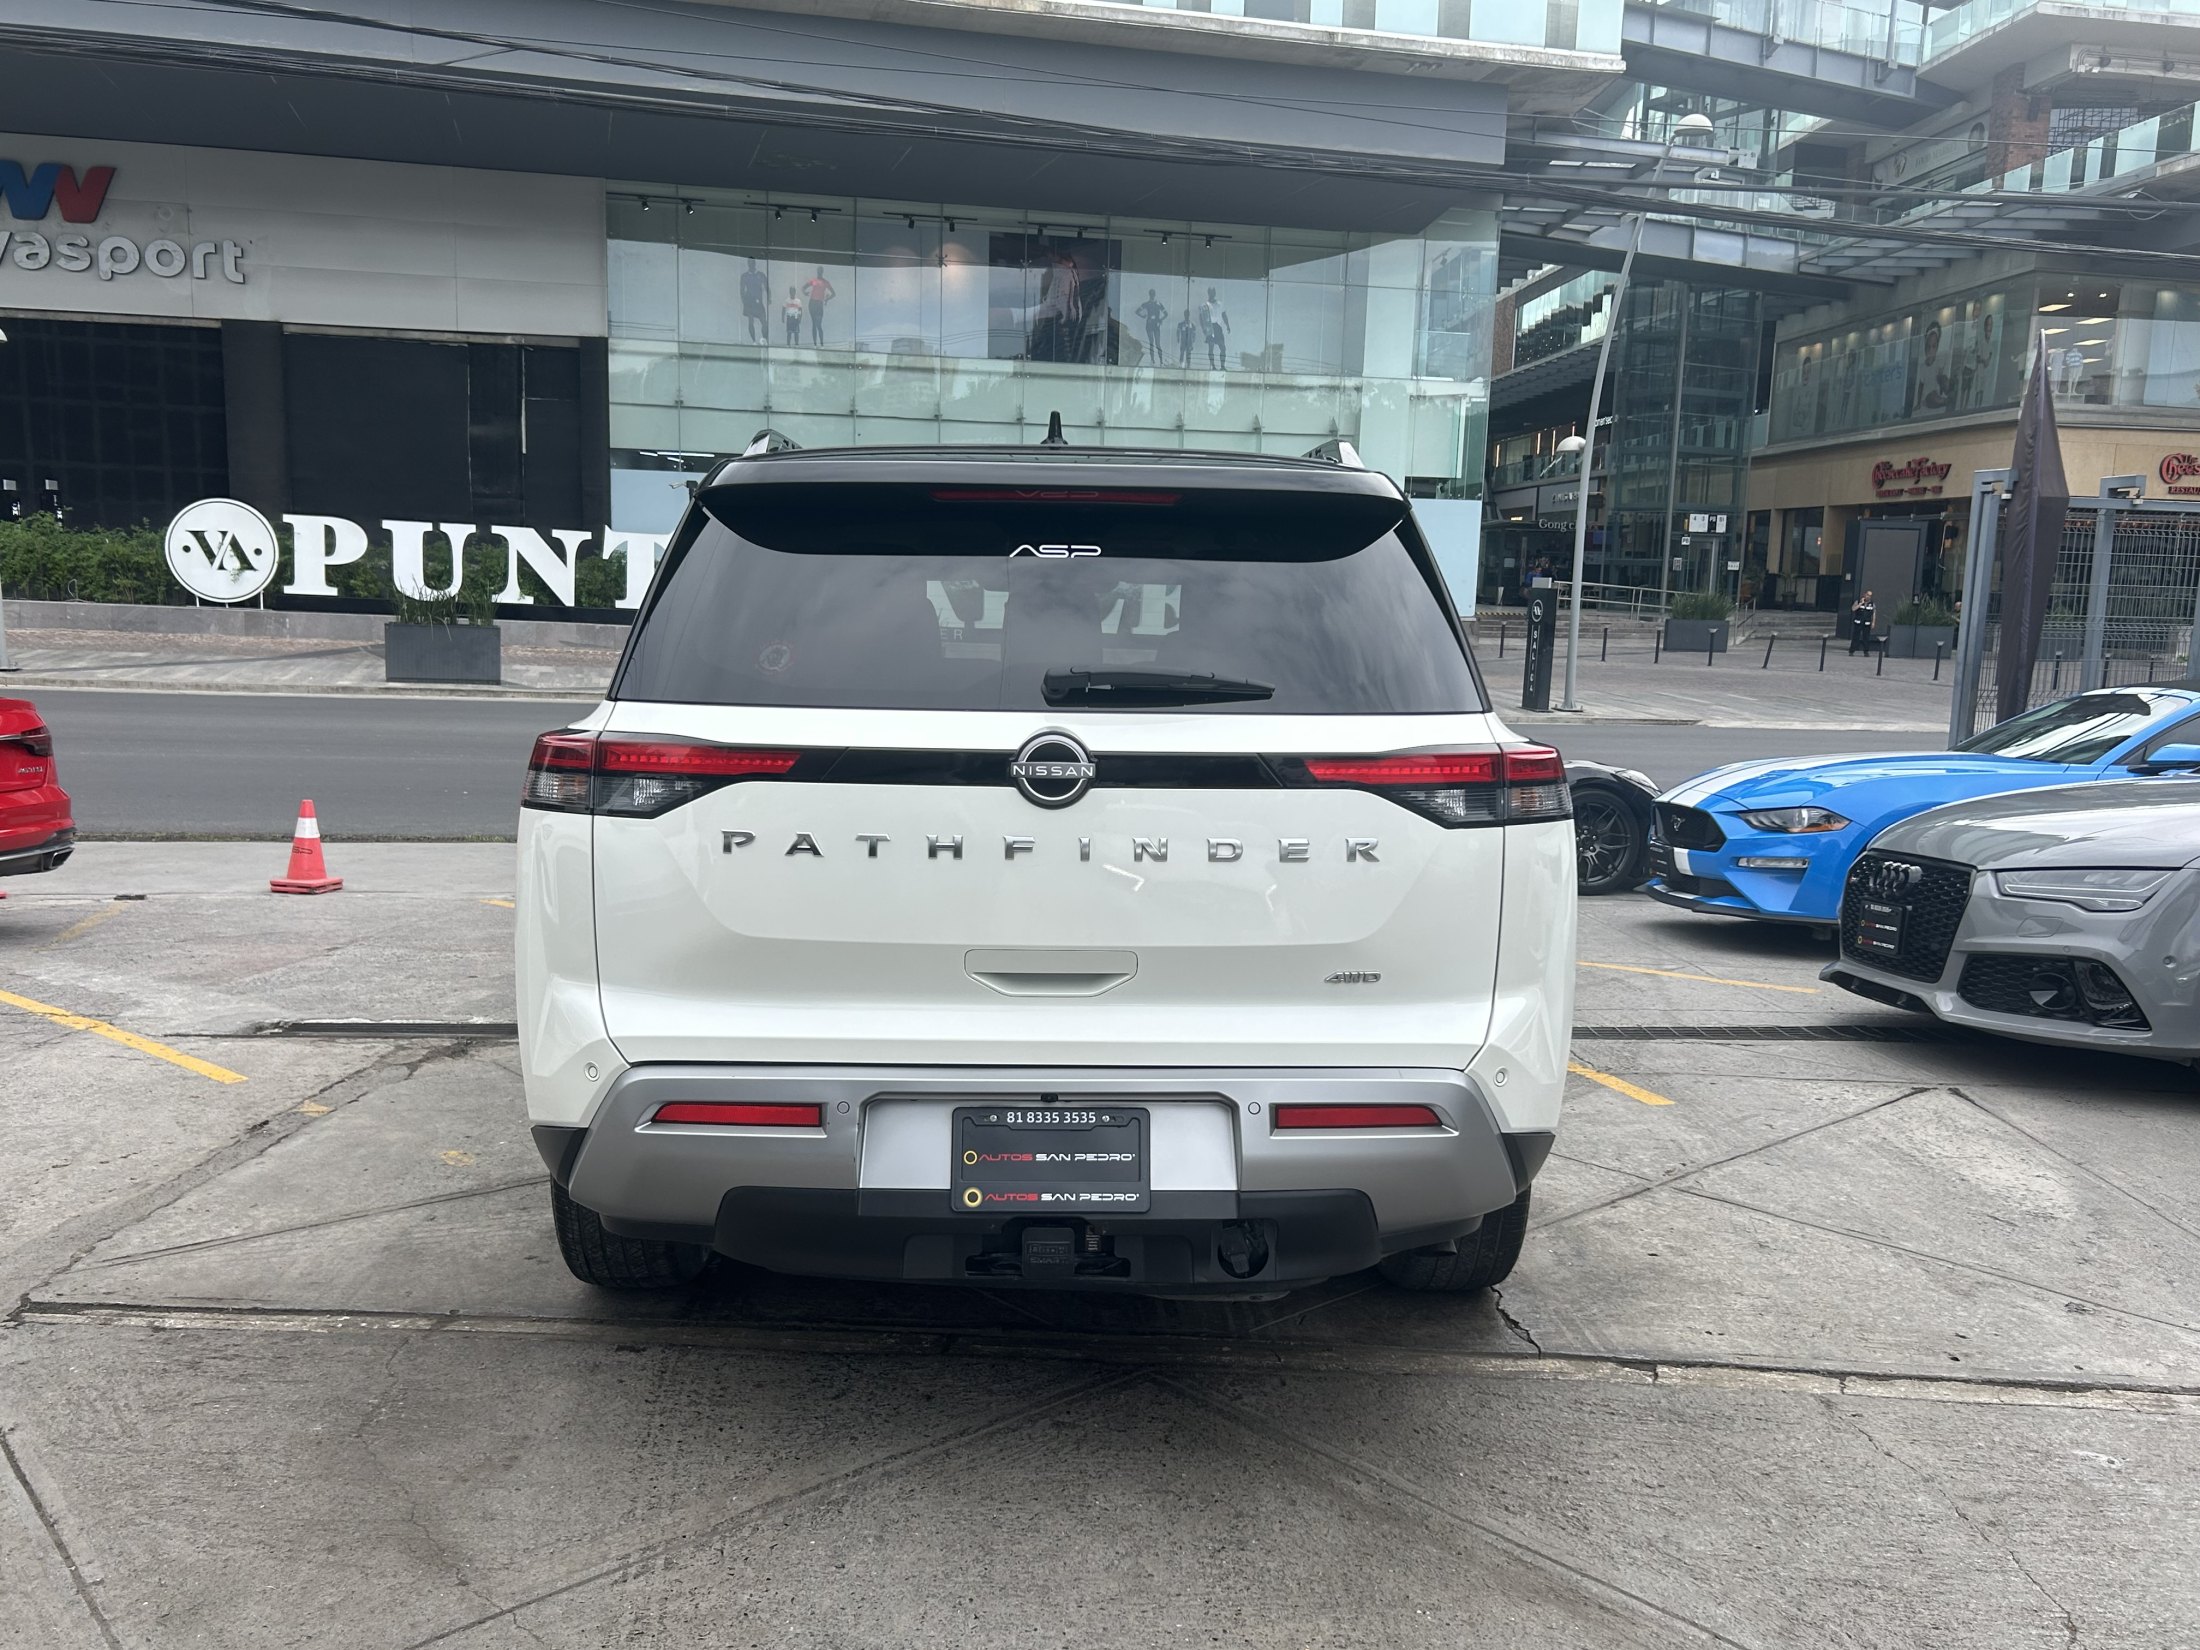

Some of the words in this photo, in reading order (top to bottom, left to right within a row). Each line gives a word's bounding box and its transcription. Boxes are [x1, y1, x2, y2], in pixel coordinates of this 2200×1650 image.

[0, 231, 246, 284] asport
[1538, 518, 1567, 532] Gong
[1009, 545, 1102, 559] ASP
[1013, 765, 1093, 776] NISSAN
[721, 828, 1381, 864] PATHFINDER
[1324, 971, 1381, 984] 4WD
[1006, 1111, 1023, 1123] 81
[1026, 1111, 1060, 1123] 8335
[1063, 1112, 1096, 1124] 3535
[979, 1153, 1033, 1161] AUTOS
[1036, 1153, 1071, 1161] SAN
[985, 1193, 1038, 1201] AUTOS
[1041, 1193, 1076, 1201] SAN
